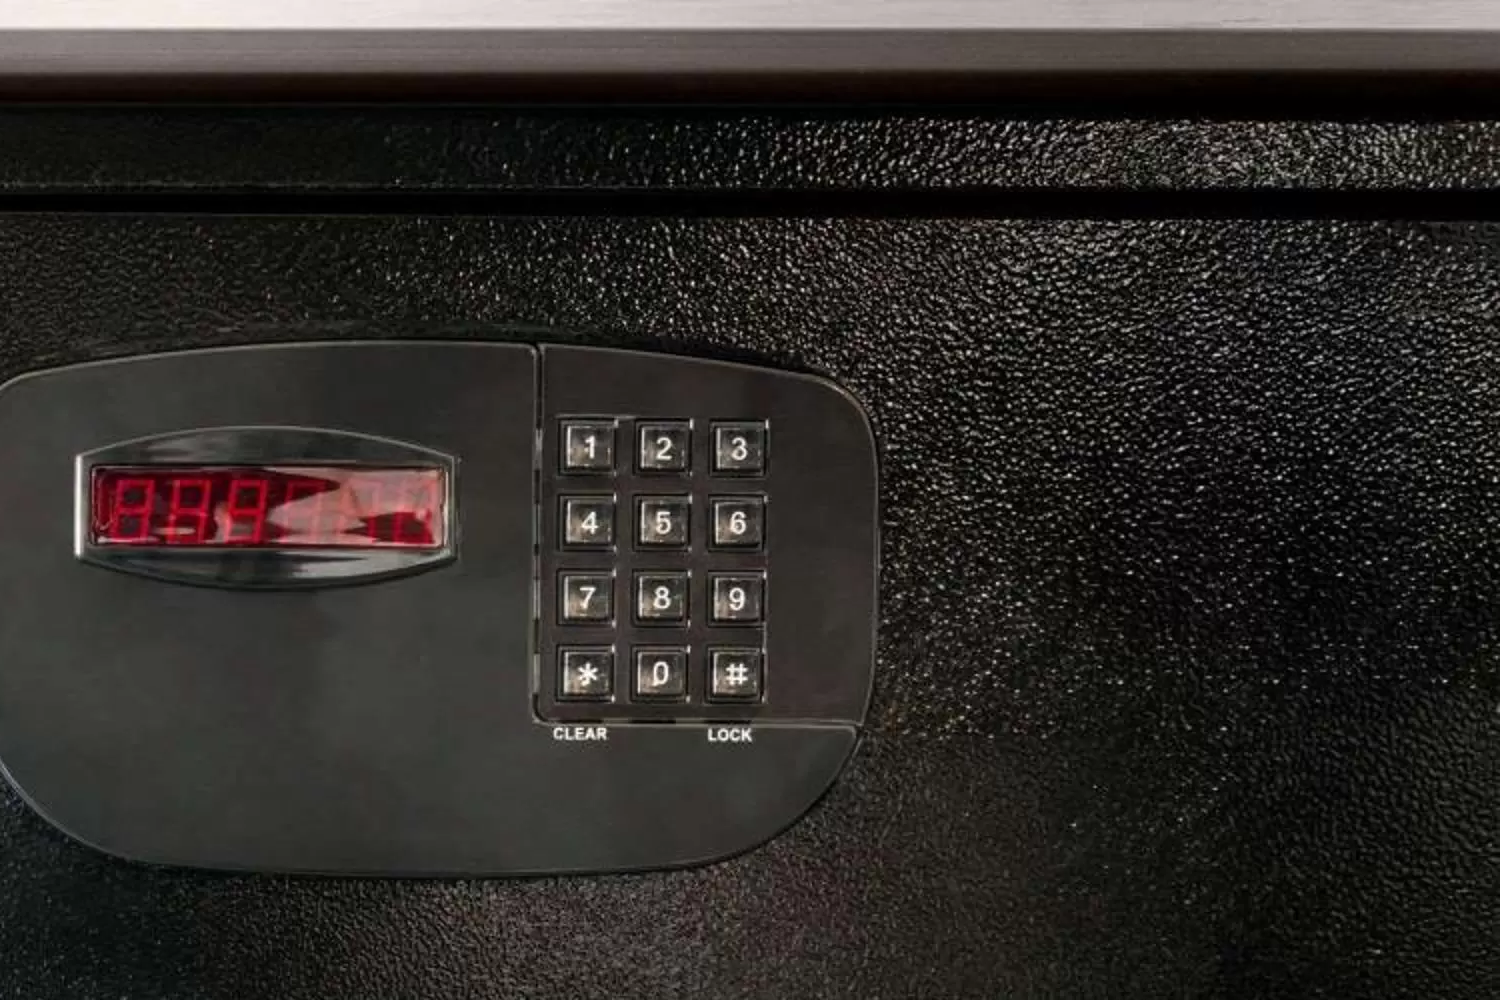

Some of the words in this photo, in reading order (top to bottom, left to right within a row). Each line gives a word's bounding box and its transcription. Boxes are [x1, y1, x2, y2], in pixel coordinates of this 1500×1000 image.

[583, 435, 596, 460] 1
[655, 436, 673, 461] 2
[730, 436, 748, 461] 3
[580, 510, 599, 535] 4
[654, 510, 672, 535] 5
[729, 510, 747, 535] 6
[579, 586, 597, 610] 7
[653, 585, 672, 610] 8
[728, 586, 746, 611] 9
[651, 661, 670, 686] 0
[552, 724, 608, 741] CLEAR
[707, 727, 753, 742] LOCK
